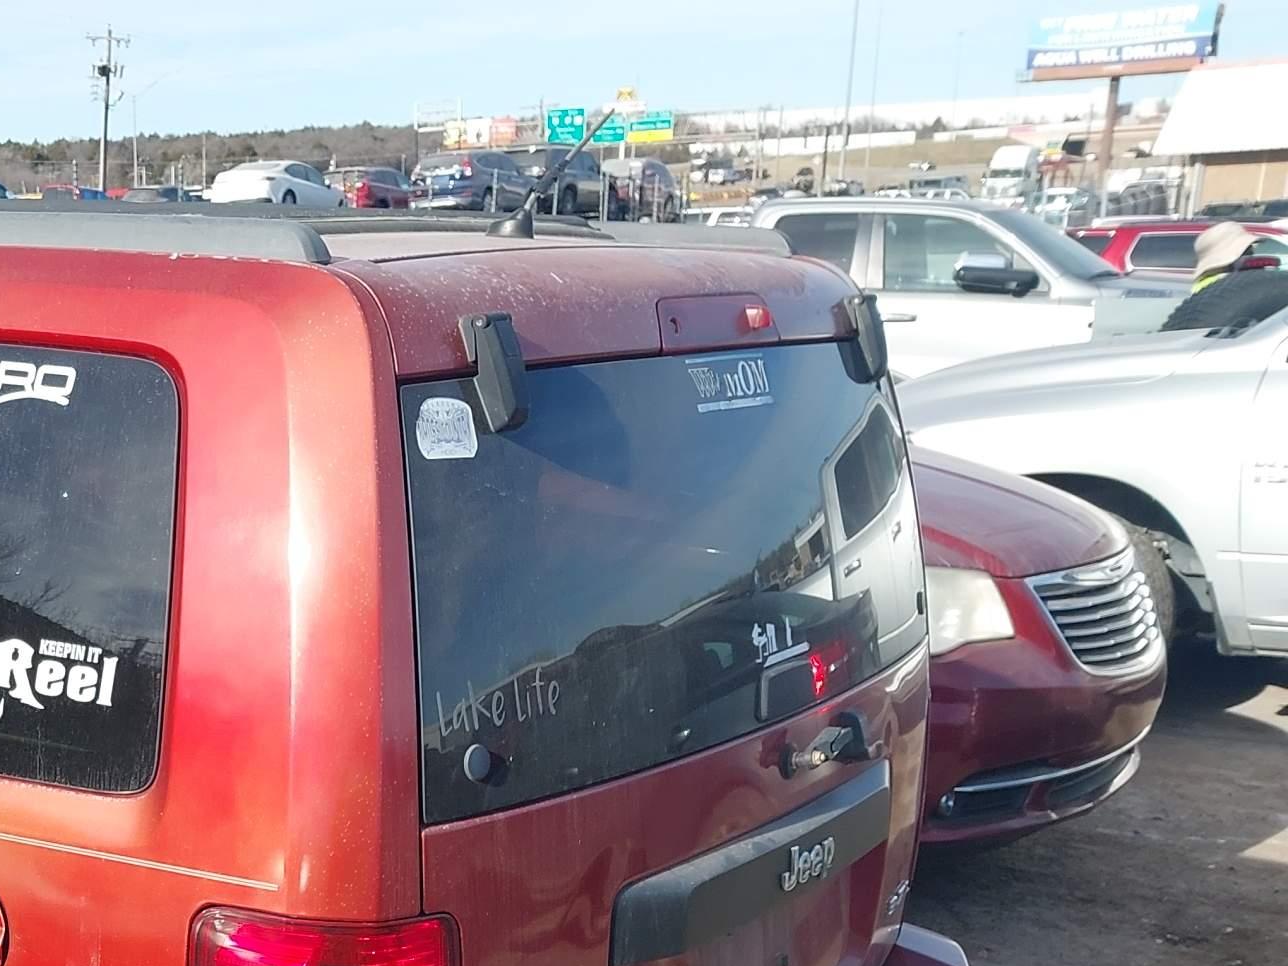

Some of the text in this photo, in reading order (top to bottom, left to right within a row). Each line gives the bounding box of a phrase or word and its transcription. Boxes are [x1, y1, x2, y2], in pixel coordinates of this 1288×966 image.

[39, 639, 103, 663] KEEPIN IT
[436, 680, 506, 737] Lake
[781, 836, 836, 892] Jeep
